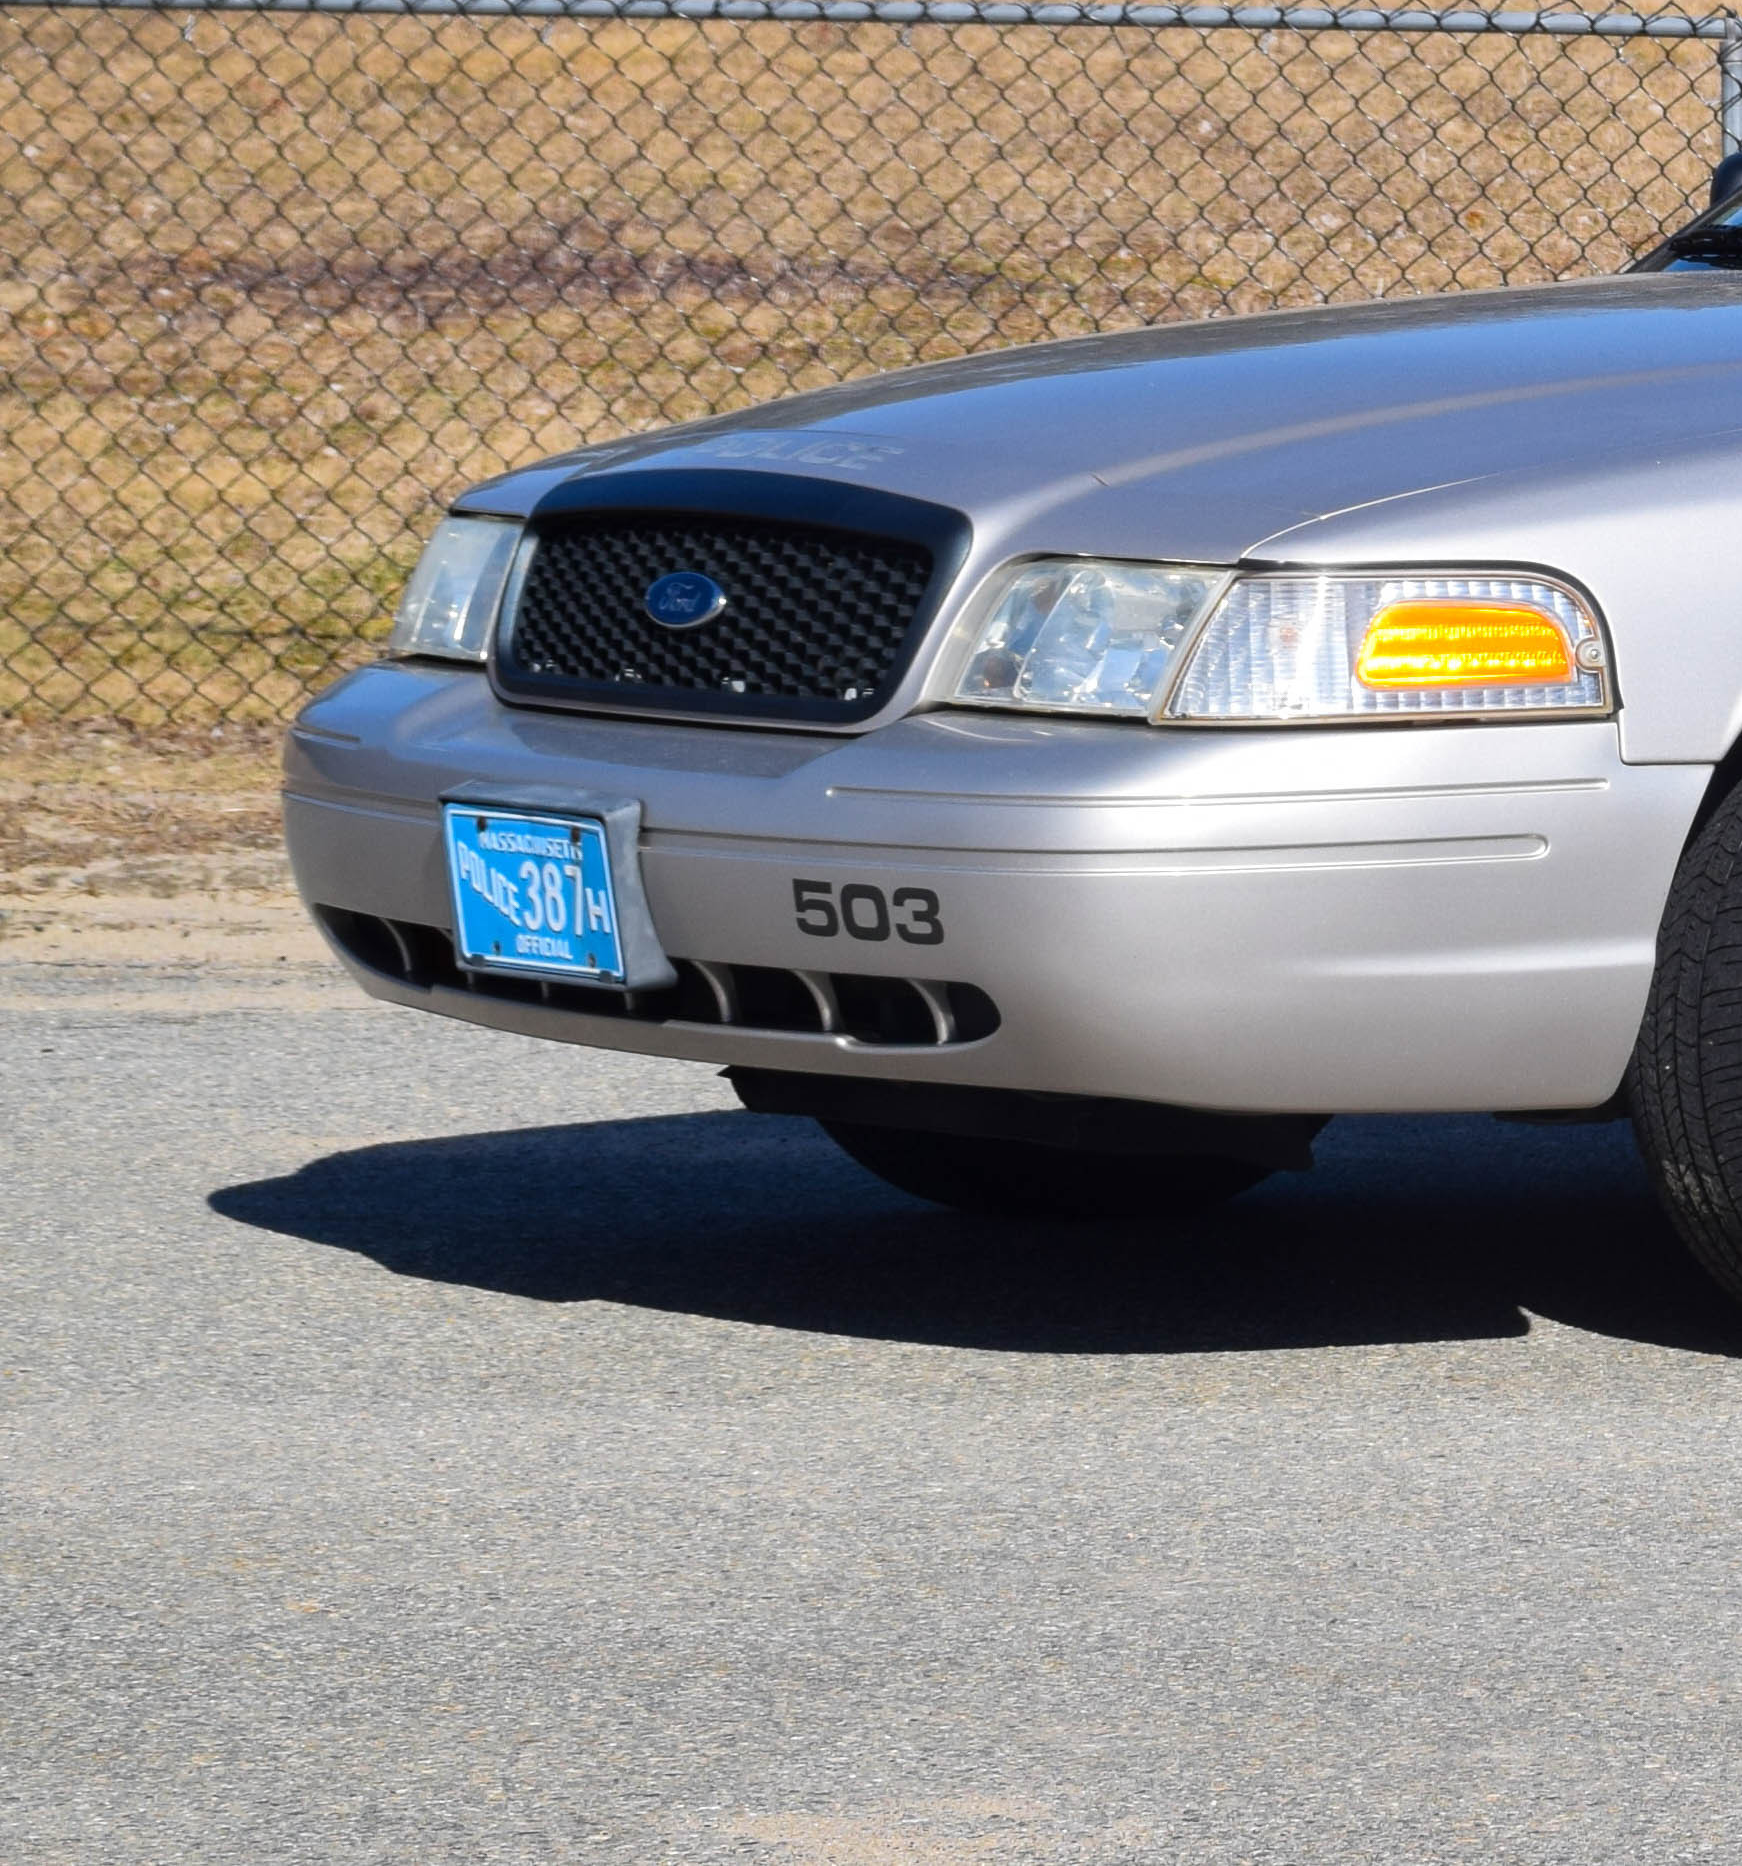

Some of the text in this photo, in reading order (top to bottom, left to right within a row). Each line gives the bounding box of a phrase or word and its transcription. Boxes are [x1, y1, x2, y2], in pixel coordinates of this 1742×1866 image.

[457, 839, 612, 938] POLICE 387 H
[792, 878, 944, 945] 503
[515, 933, 574, 960] OFFICIAL
